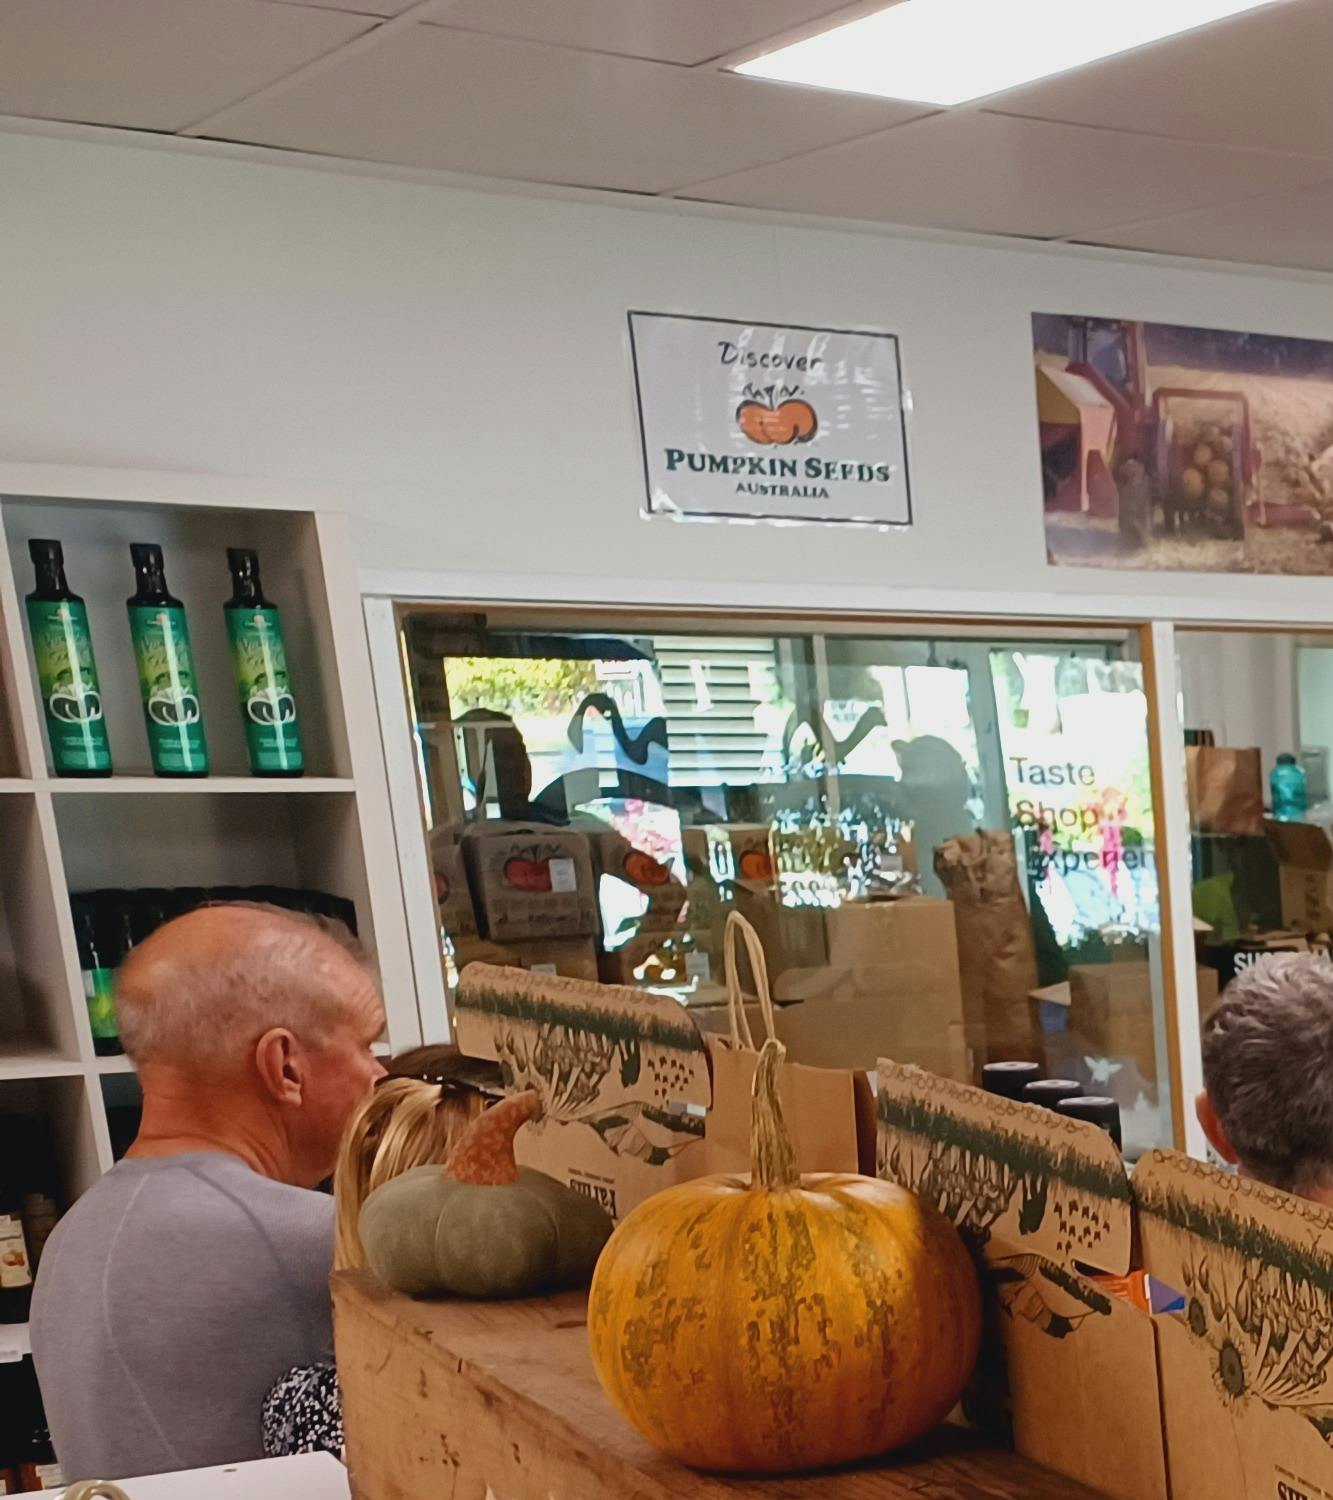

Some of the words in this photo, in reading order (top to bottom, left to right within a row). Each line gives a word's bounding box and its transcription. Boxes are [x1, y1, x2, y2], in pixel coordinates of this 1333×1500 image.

[718, 341, 823, 371] Discover
[664, 448, 798, 478] PUMPKIN
[736, 482, 830, 499] AUSTRALIA
[1009, 756, 1096, 786] Taste
[1016, 800, 1100, 833] Shop
